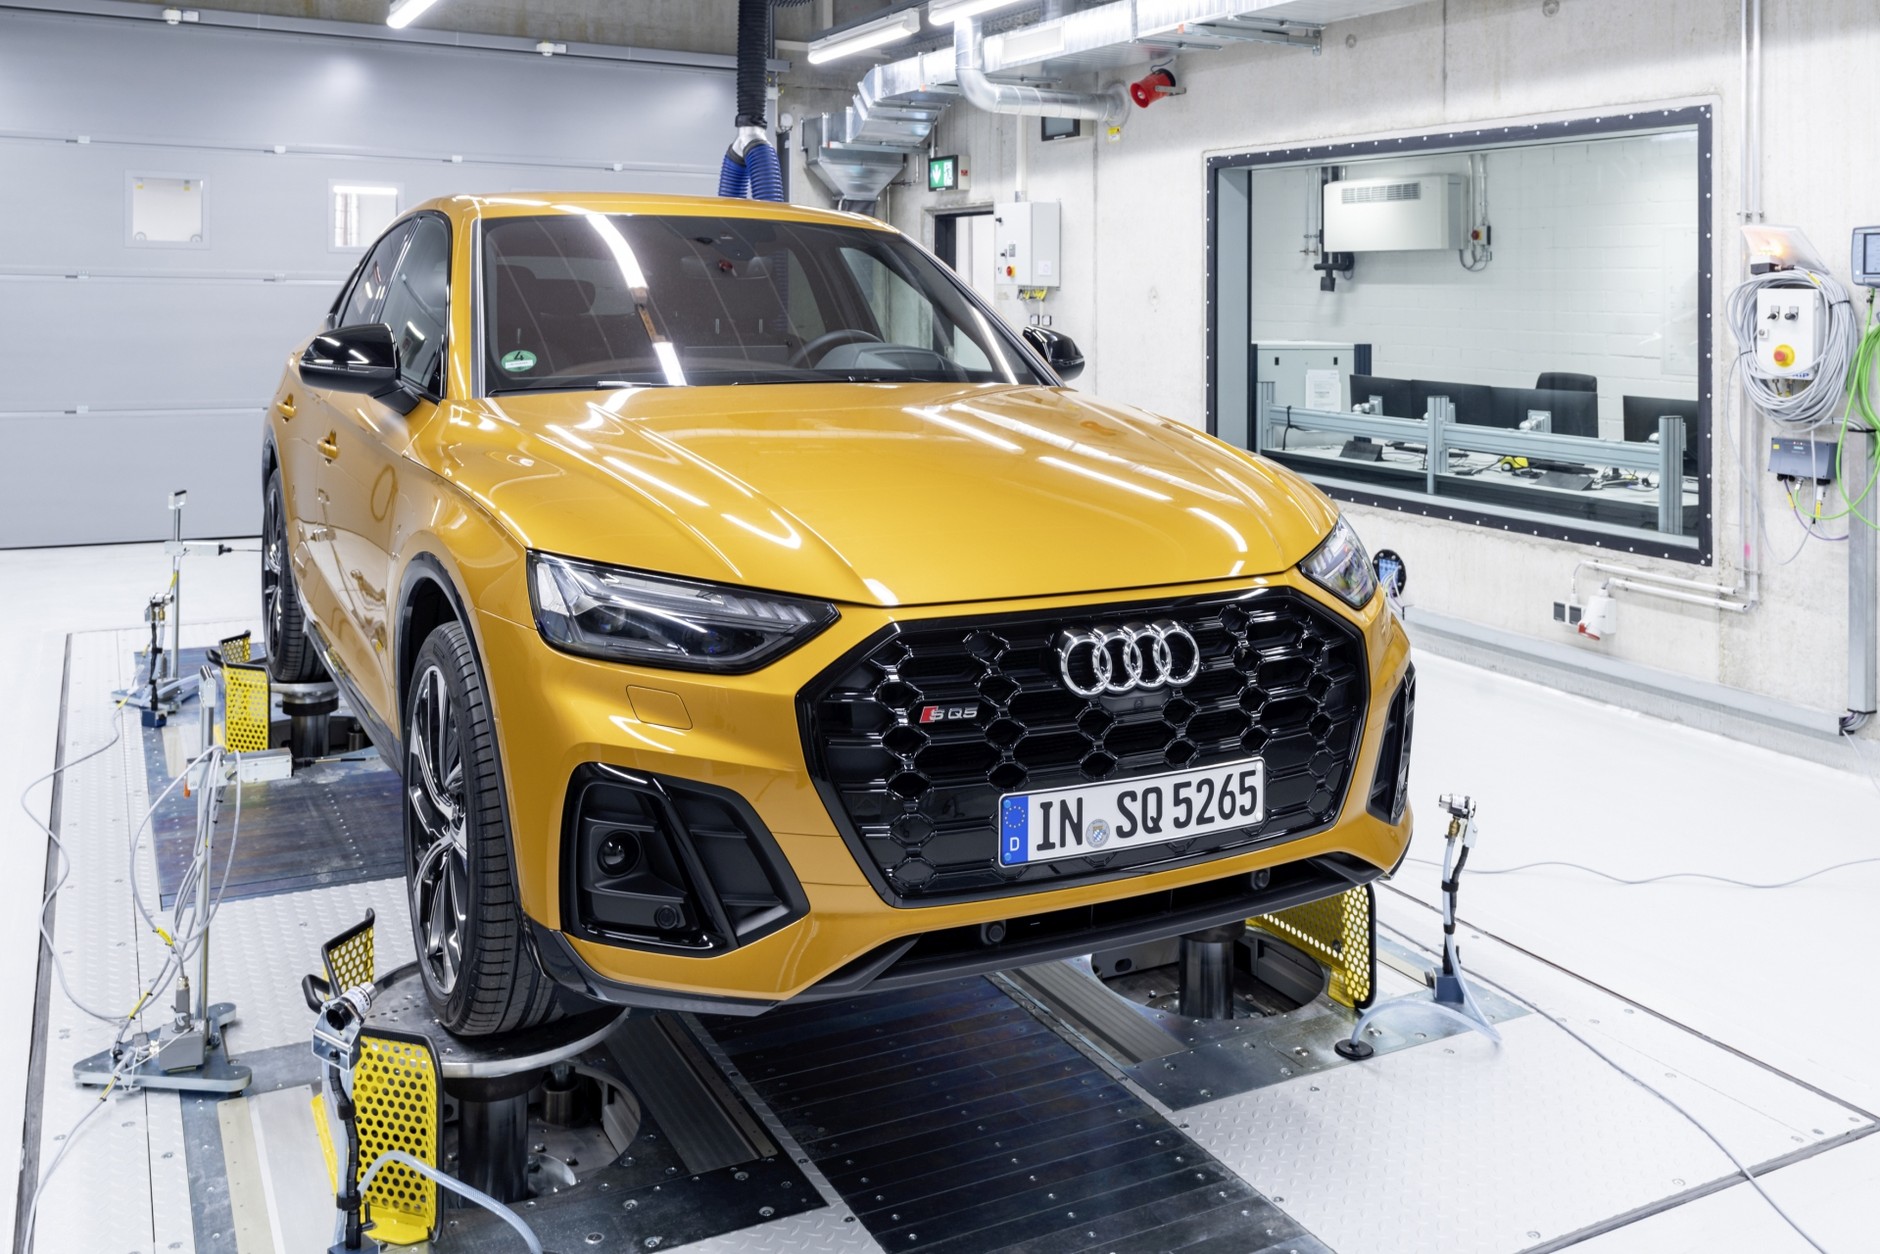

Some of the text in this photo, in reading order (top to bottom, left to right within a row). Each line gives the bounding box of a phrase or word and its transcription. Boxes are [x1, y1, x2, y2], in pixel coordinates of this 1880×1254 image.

[513, 351, 524, 360] 4
[1036, 797, 1083, 852] IN
[1115, 786, 1163, 839] SQ
[1172, 769, 1257, 830] 5265
[1009, 836, 1020, 852] D
